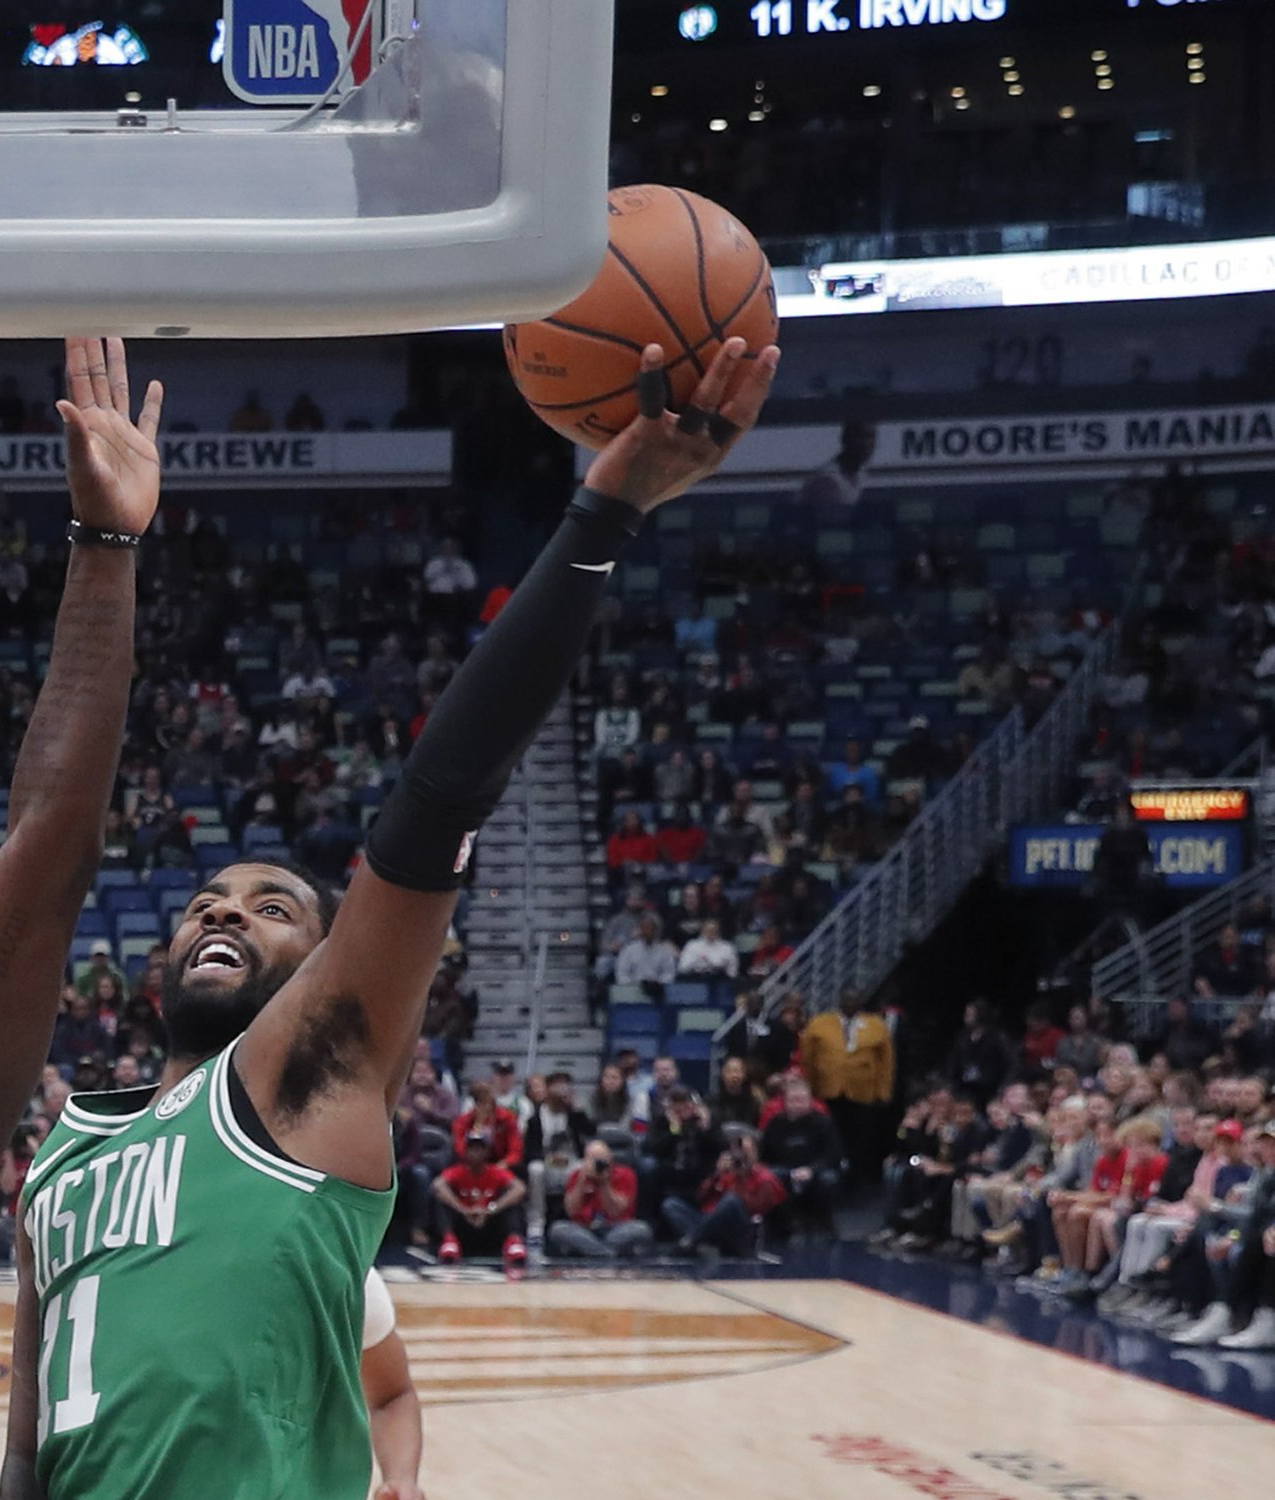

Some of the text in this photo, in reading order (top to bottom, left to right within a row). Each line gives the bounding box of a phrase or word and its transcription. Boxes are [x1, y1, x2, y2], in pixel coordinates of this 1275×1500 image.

[751, 0, 792, 36] 11
[807, 0, 851, 33] K.
[859, 0, 1007, 29] IRVING
[247, 24, 320, 79] NBA
[163, 438, 314, 470] KREWE
[901, 421, 1108, 458] MOORE'S
[1130, 790, 1245, 810] EMERGENCY
[1164, 807, 1209, 822] EXIT
[24, 1134, 186, 1299] OSTON
